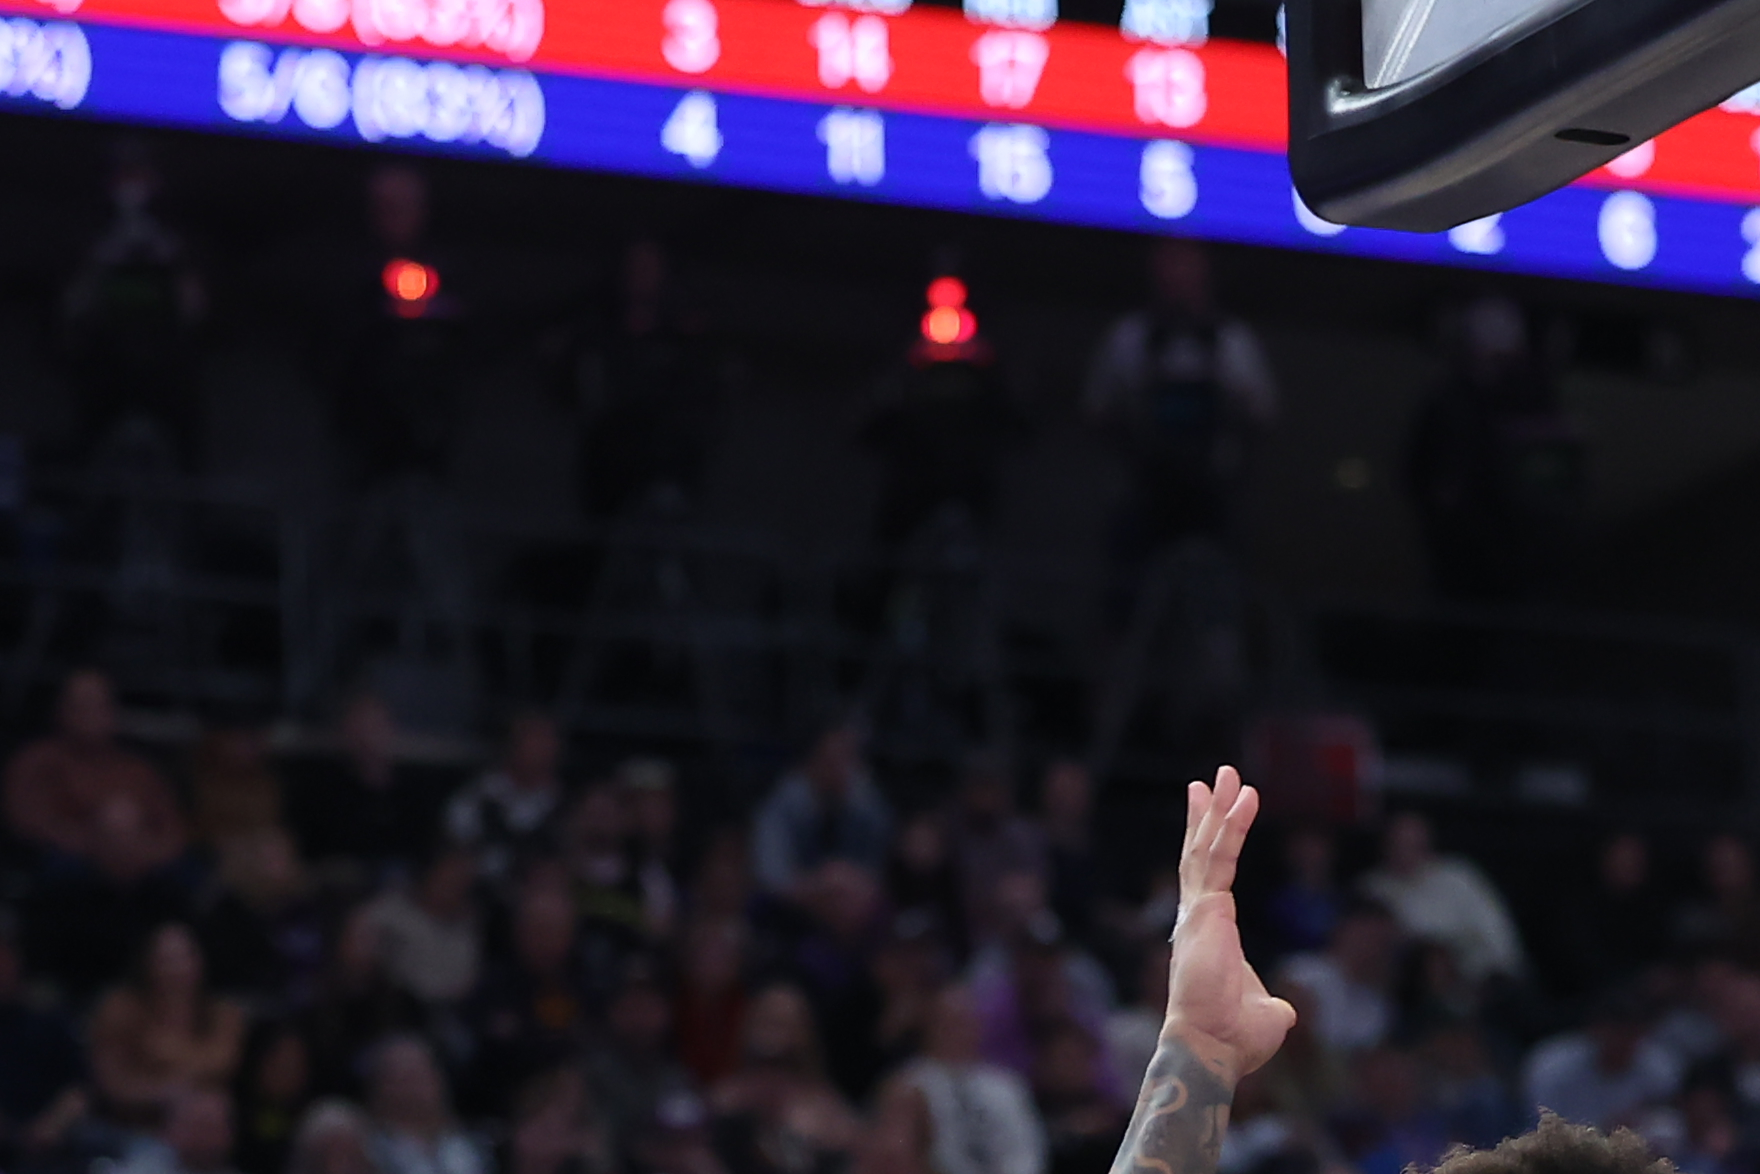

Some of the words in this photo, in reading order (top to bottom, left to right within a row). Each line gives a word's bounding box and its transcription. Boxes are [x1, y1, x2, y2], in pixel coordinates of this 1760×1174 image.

[661, 0, 720, 73] 3
[969, 29, 1049, 109] 17
[1124, 47, 1207, 128] 13
[661, 90, 722, 168] 4
[817, 107, 886, 186] 11
[969, 122, 1053, 203] 15
[1138, 138, 1196, 219] 5
